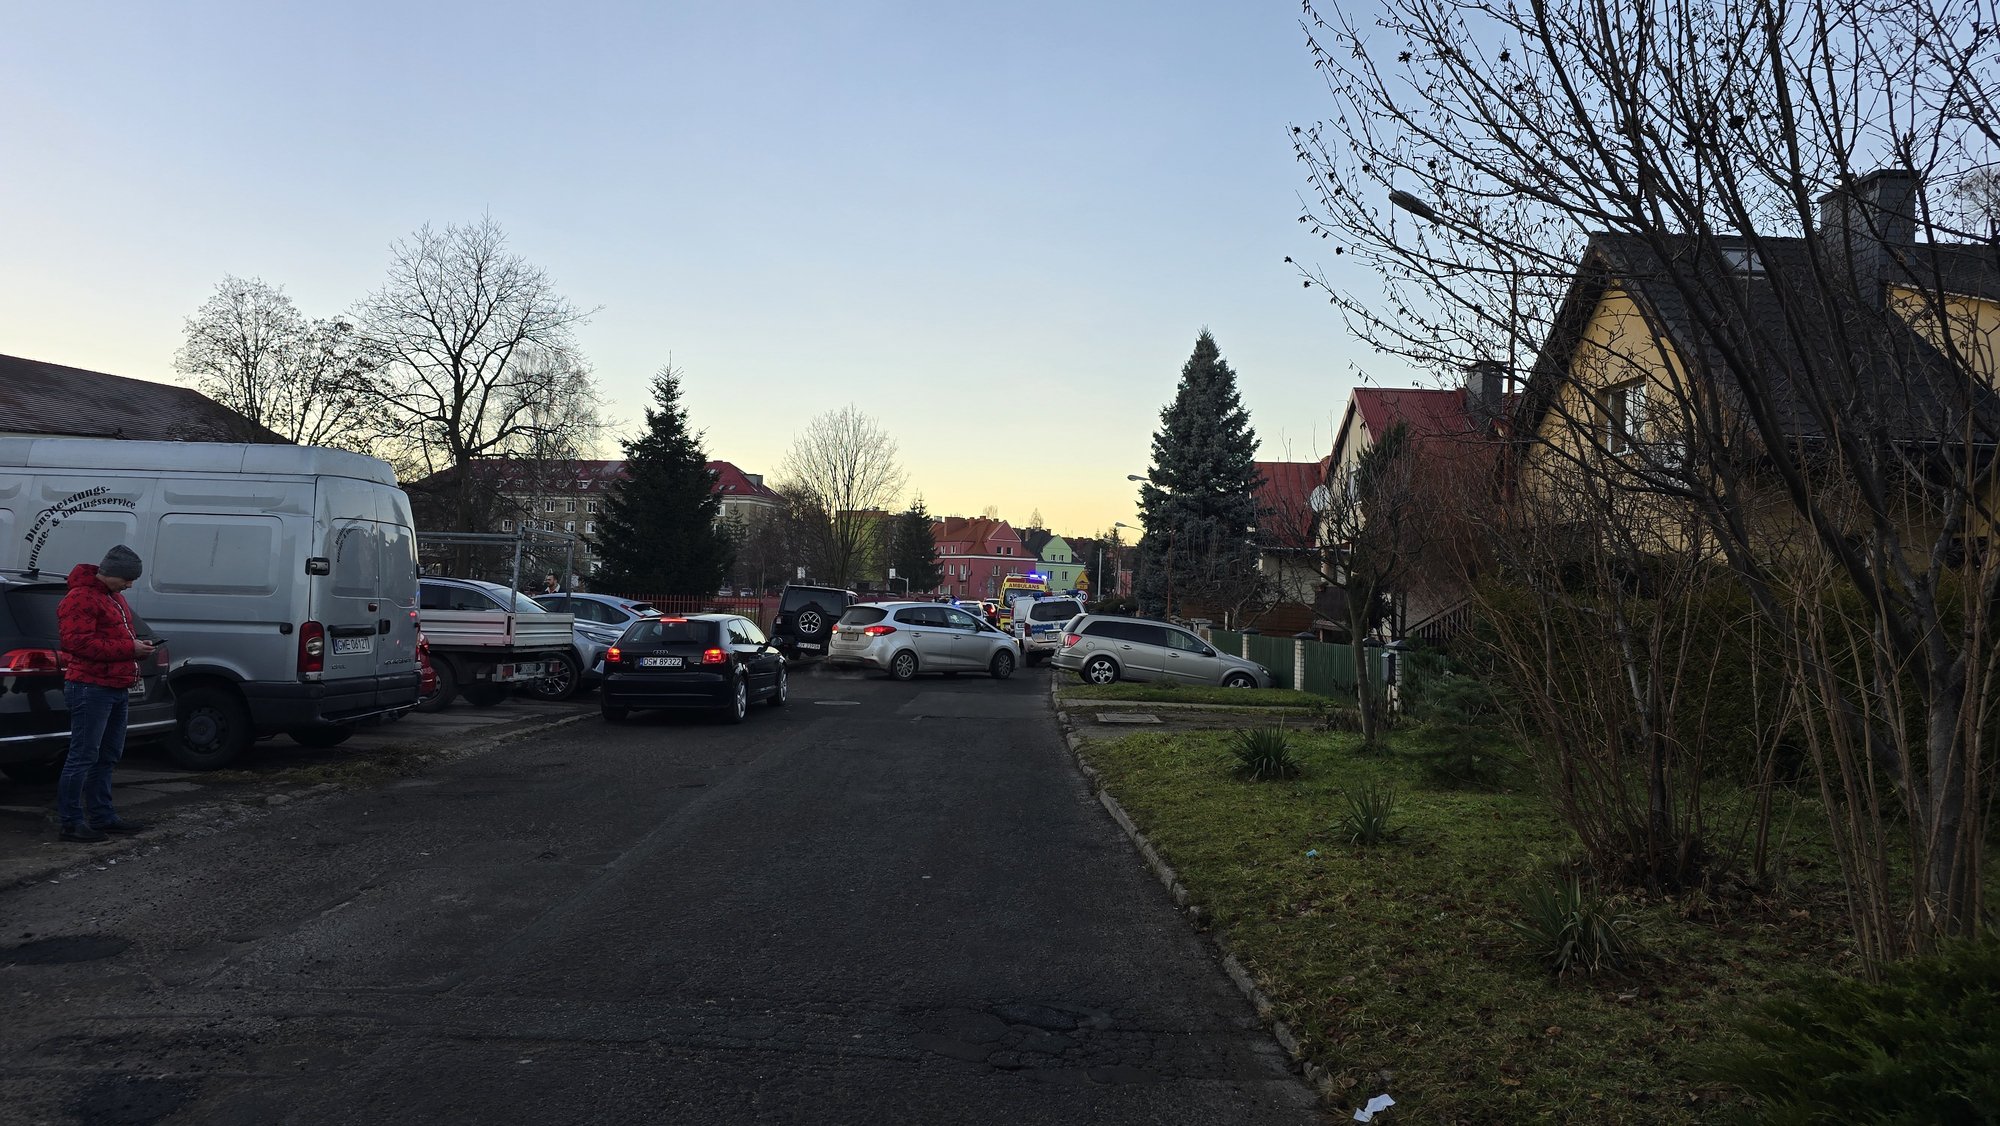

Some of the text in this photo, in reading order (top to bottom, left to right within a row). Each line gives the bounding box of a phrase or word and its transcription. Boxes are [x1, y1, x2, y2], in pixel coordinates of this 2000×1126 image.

[1008, 582, 1040, 590] AMBULANS
[643, 657, 681, 666] DSW 89322
